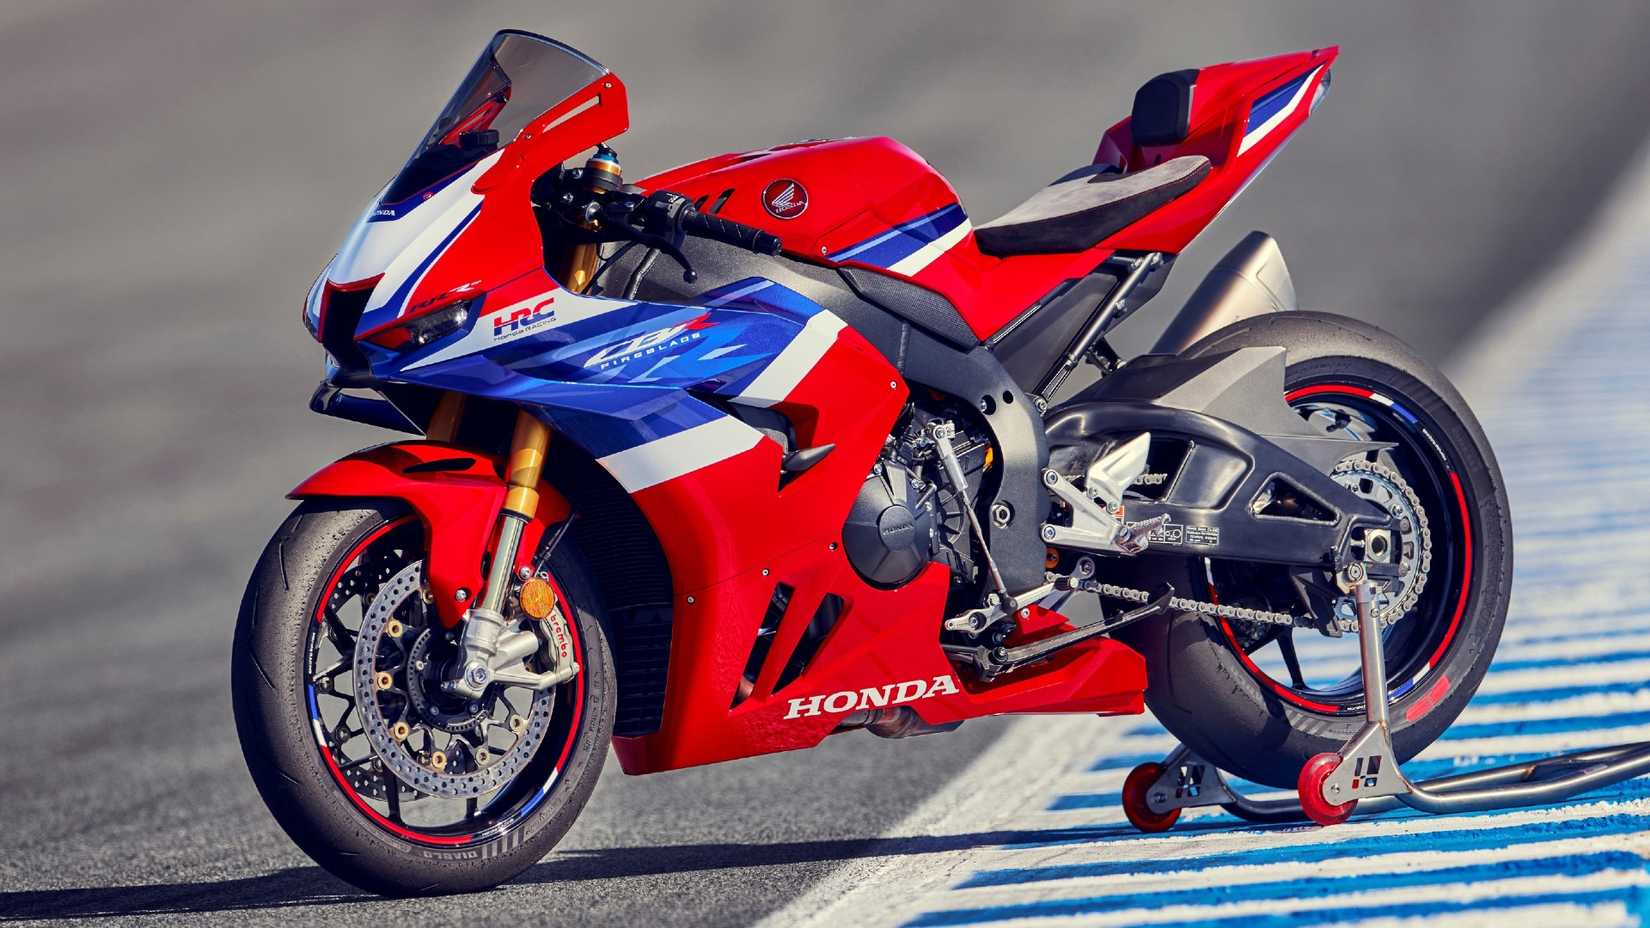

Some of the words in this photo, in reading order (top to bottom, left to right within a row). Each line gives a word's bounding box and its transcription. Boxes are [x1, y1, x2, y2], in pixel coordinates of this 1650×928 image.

[494, 297, 555, 336] HRC
[550, 614, 568, 658] brembo
[783, 674, 960, 720] HONDA
[423, 850, 478, 861] DIABLO
